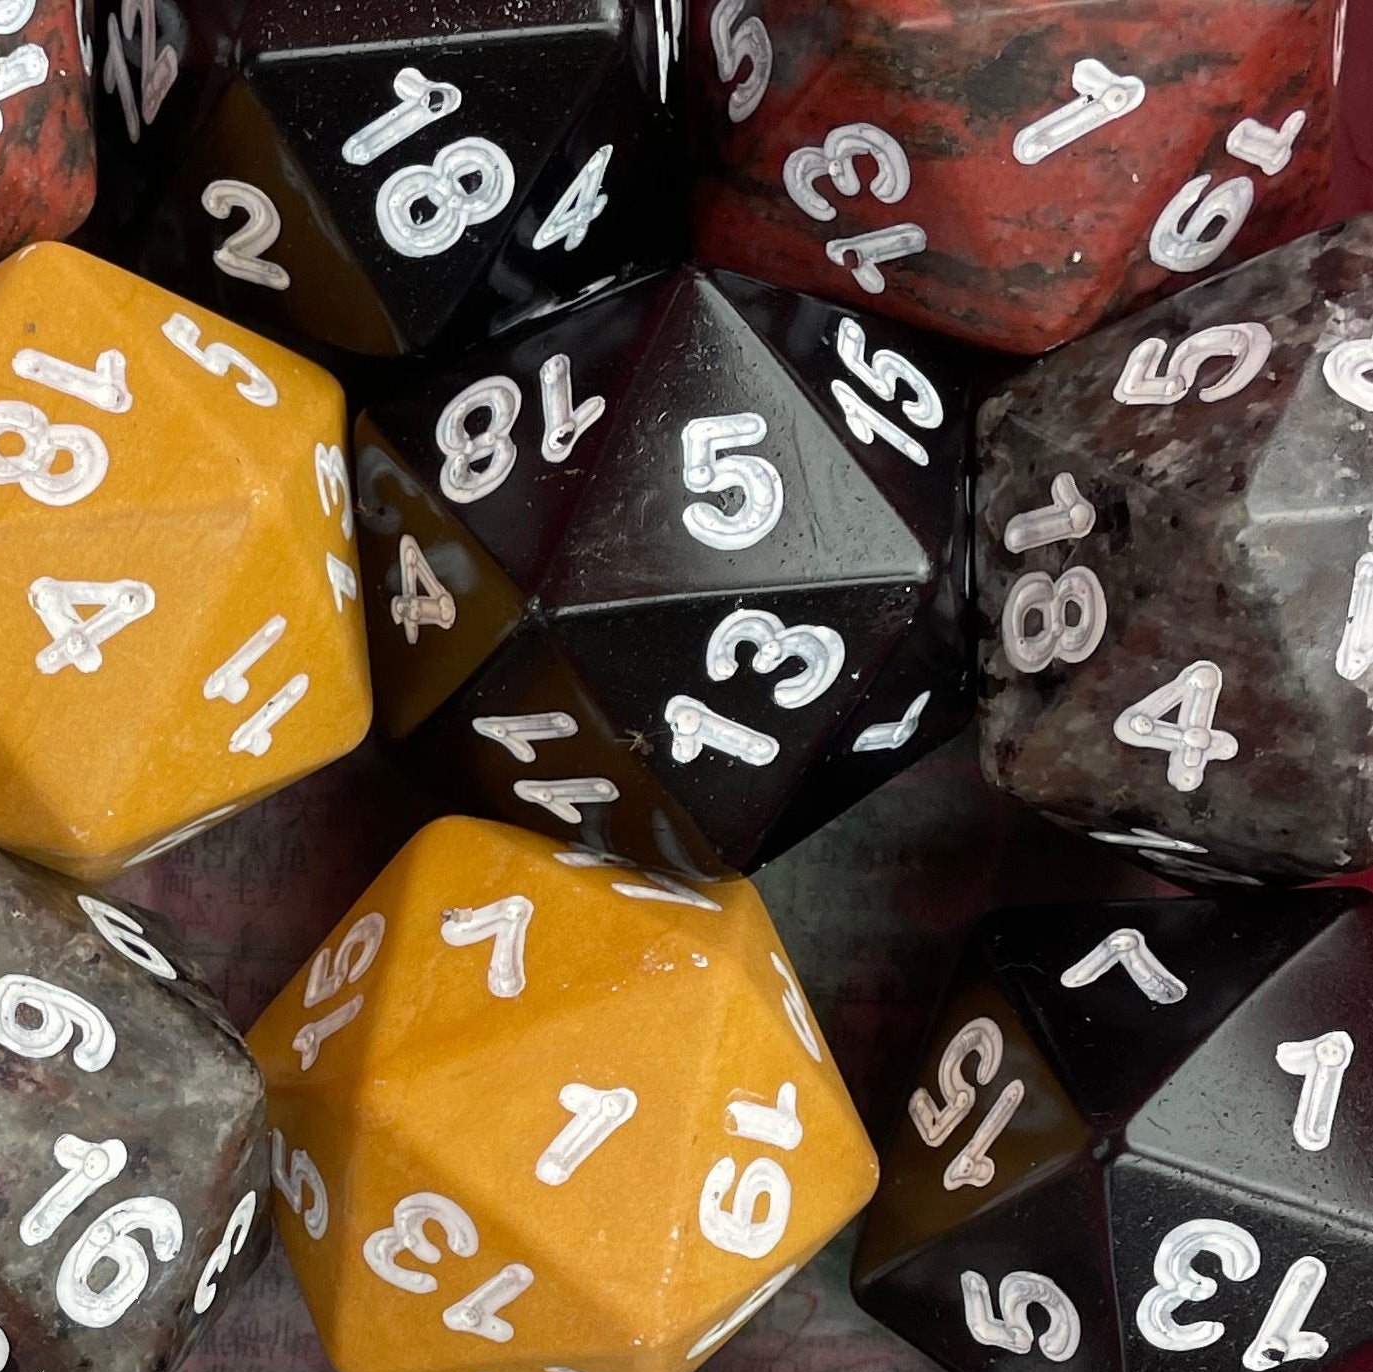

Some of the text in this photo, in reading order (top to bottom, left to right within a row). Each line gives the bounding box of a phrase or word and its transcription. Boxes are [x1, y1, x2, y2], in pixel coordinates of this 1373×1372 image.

[342, 67, 515, 257] 18
[1013, 58, 1145, 165] 1
[201, 179, 290, 290] 2
[532, 144, 613, 252] 4
[783, 122, 927, 294] 13
[1148, 110, 1306, 272] 19
[161, 312, 278, 407] 5
[831, 317, 944, 466] 15
[1113, 321, 1272, 406] 5
[434, 353, 606, 503] 18
[681, 412, 784, 551] 5
[28, 575, 155, 674] 4
[391, 534, 457, 644] 4
[1001, 471, 1107, 674] 18
[664, 608, 846, 766] 13
[1113, 659, 1238, 791] 4
[471, 711, 621, 824] 11
[292, 912, 385, 1070] 15
[440, 895, 534, 998] 7
[535, 1082, 637, 1185] 1
[908, 1017, 1024, 1191] 15
[1276, 1030, 1354, 1151] 1
[20, 1133, 183, 1328] 16
[270, 1128, 328, 1240] 5
[699, 1082, 803, 1258] 19
[363, 1191, 533, 1343] 13
[960, 1270, 1082, 1362] 5
[1135, 1218, 1328, 1372] 13
